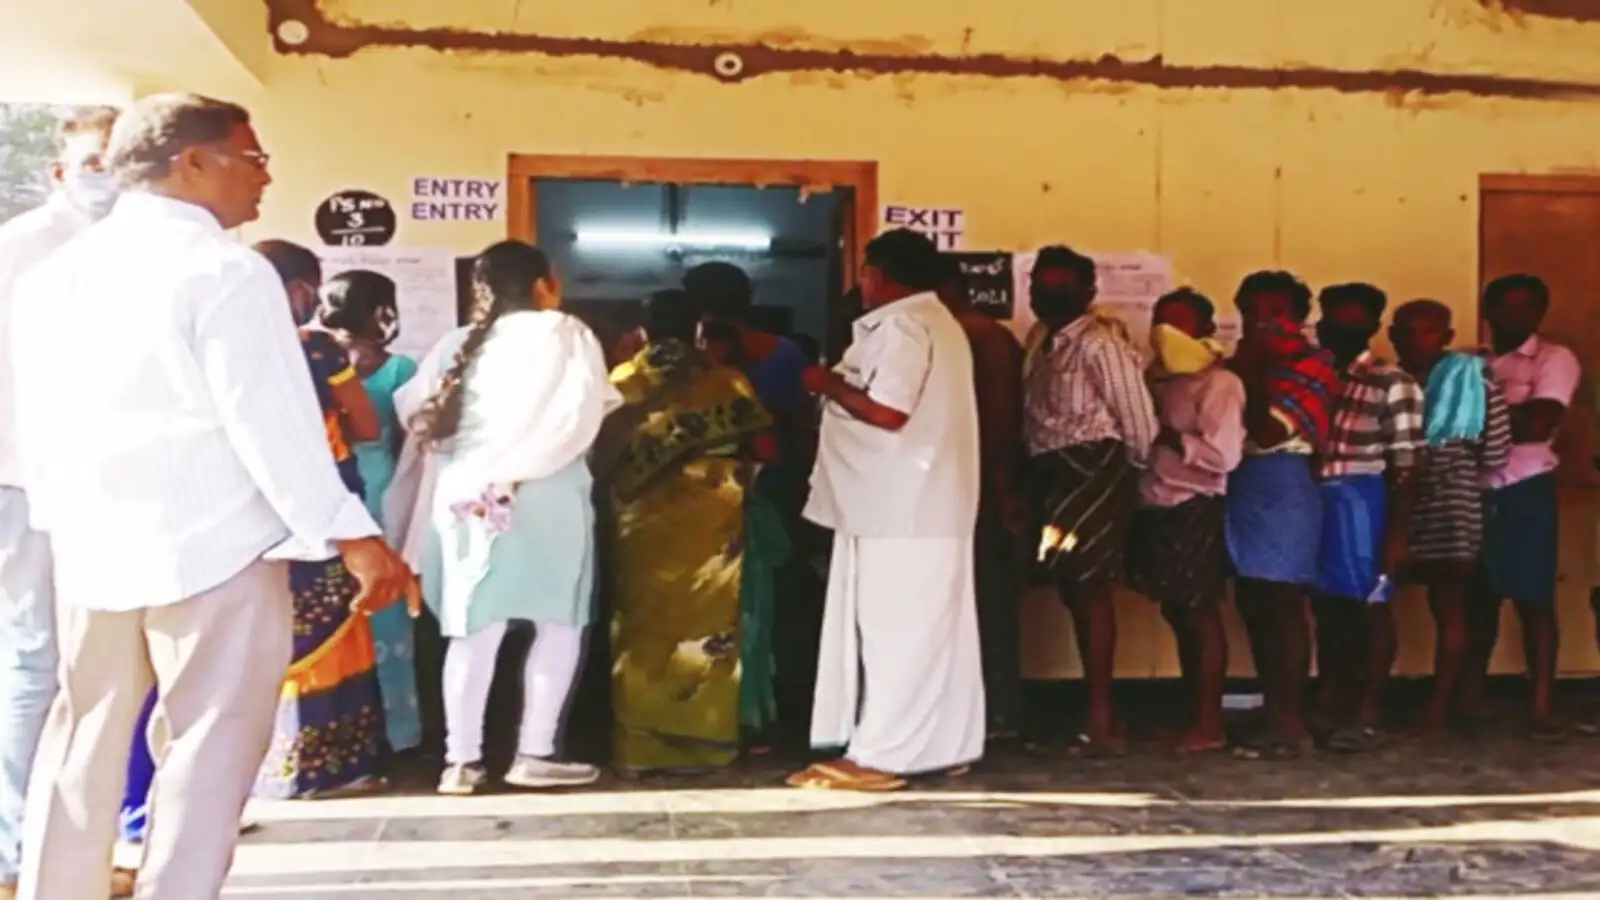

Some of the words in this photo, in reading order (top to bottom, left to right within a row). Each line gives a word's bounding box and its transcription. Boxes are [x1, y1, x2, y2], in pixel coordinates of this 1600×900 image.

[413, 178, 500, 198] ENTRY
[346, 212, 365, 228] 3
[411, 202, 498, 221] ENTRY
[885, 206, 963, 227] EXIT
